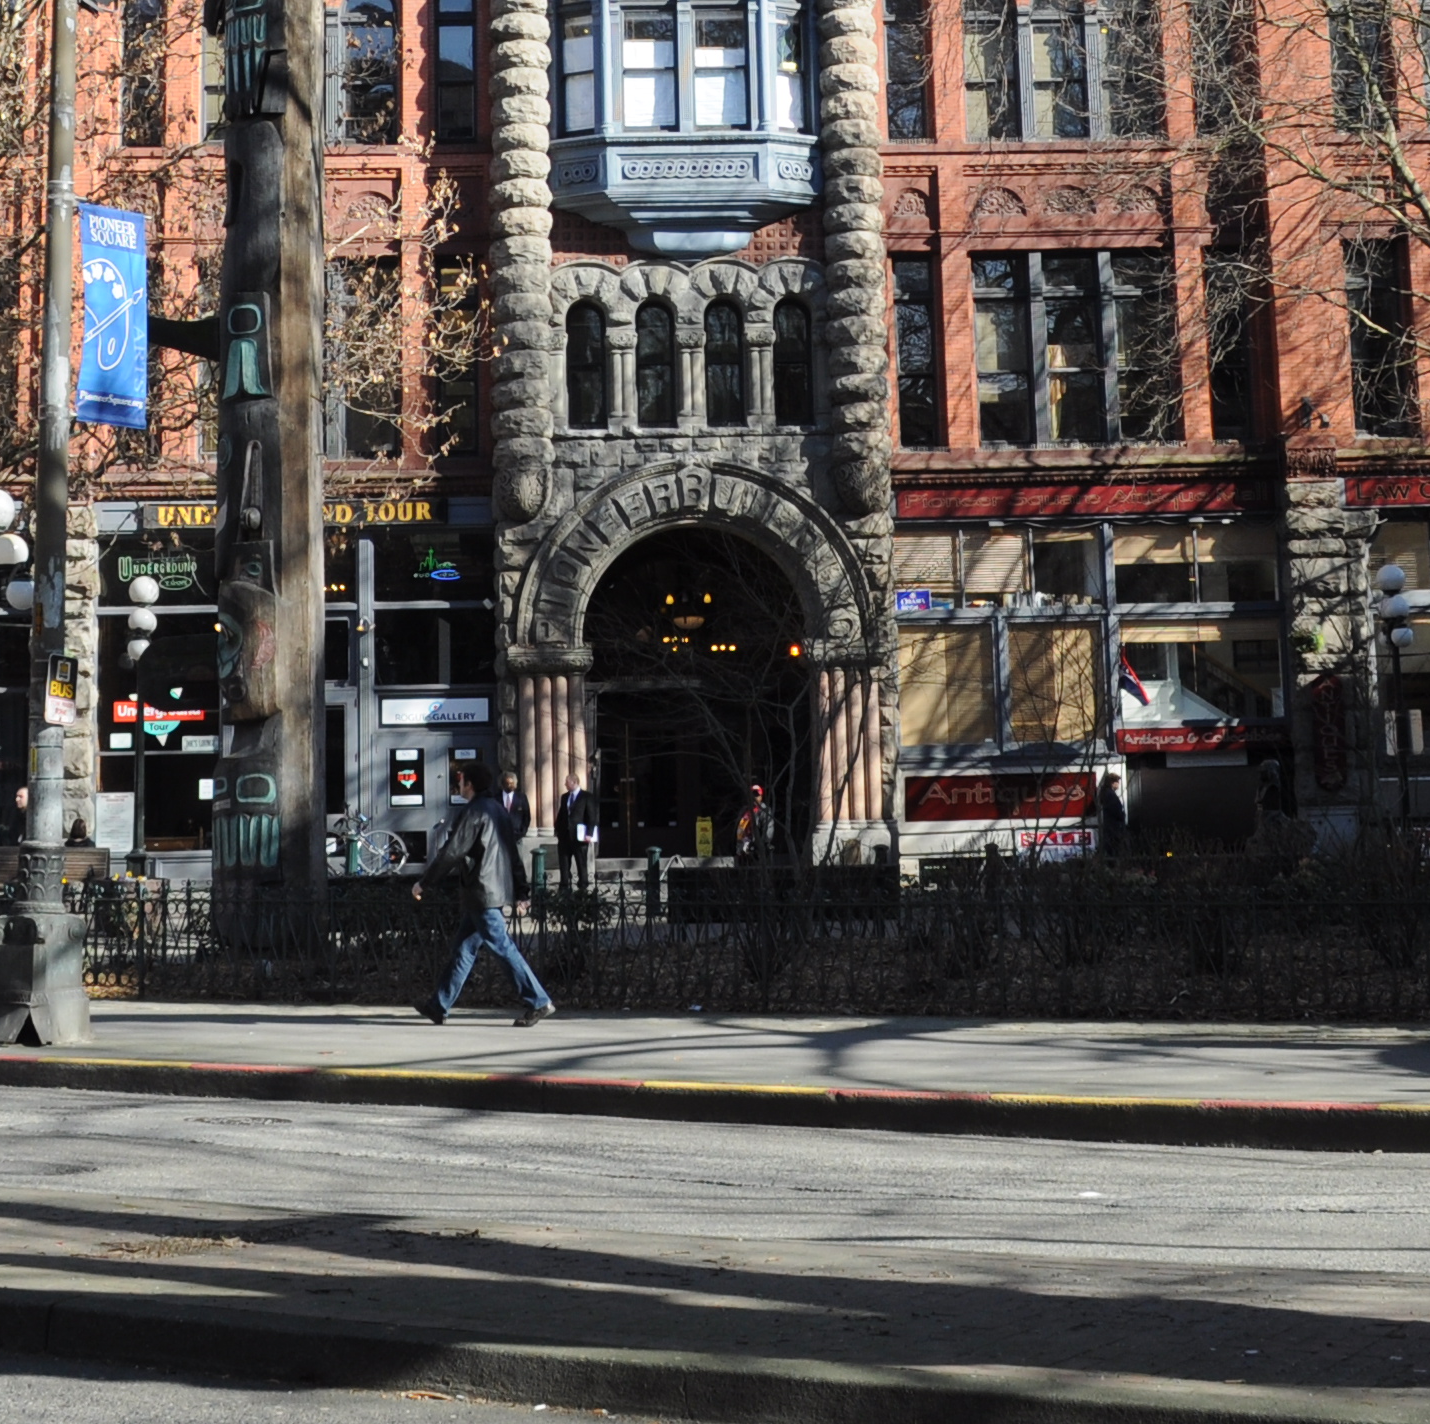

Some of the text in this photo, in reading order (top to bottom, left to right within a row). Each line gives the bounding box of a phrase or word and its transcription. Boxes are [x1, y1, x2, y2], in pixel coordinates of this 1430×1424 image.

[88, 214, 137, 236] PIONEER
[90, 228, 137, 250] SQUARE
[133, 326, 145, 393] ARTS
[904, 492, 1003, 509] Pioneer
[1009, 490, 1101, 513] Square
[1106, 489, 1210, 514] Antique
[1356, 483, 1410, 500] LAW
[364, 502, 432, 522] TOUR
[537, 480, 676, 642] PIONEER
[50, 680, 74, 698] BUS
[149, 722, 170, 731] Tour
[432, 712, 476, 721] GALLERY
[1124, 733, 1184, 750] Antiques
[1187, 732, 1199, 743] &
[919, 781, 1086, 816] Antiques
[1022, 833, 1090, 847] SALE
